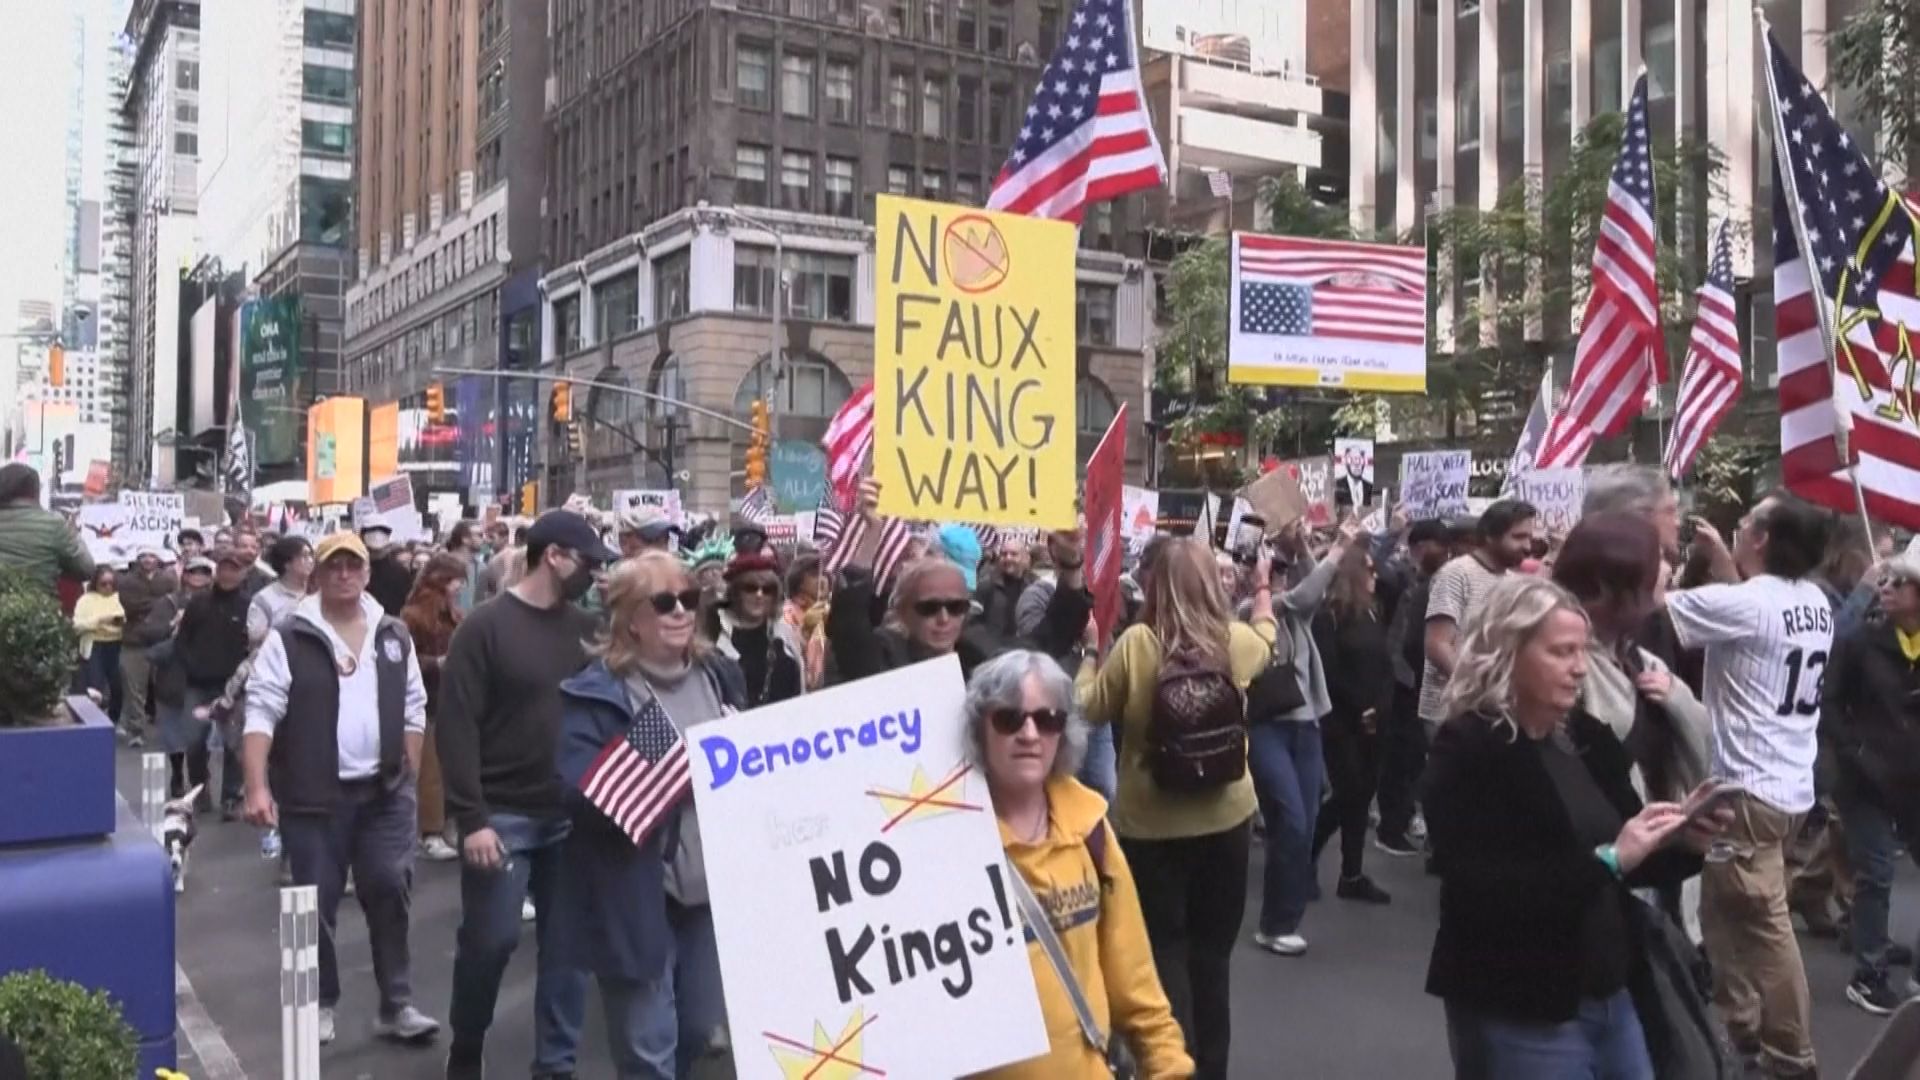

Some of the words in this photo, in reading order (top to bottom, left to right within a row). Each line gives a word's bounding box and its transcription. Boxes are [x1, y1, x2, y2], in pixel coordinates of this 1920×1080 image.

[895, 293, 1047, 371] FAUX
[896, 365, 1055, 450] KING
[124, 493, 182, 509] SILENCE
[628, 495, 641, 507] NO
[896, 446, 1037, 515] WAY!
[699, 707, 923, 790] Democracy
[808, 840, 902, 914] NO
[824, 863, 1015, 1003] Kings!
